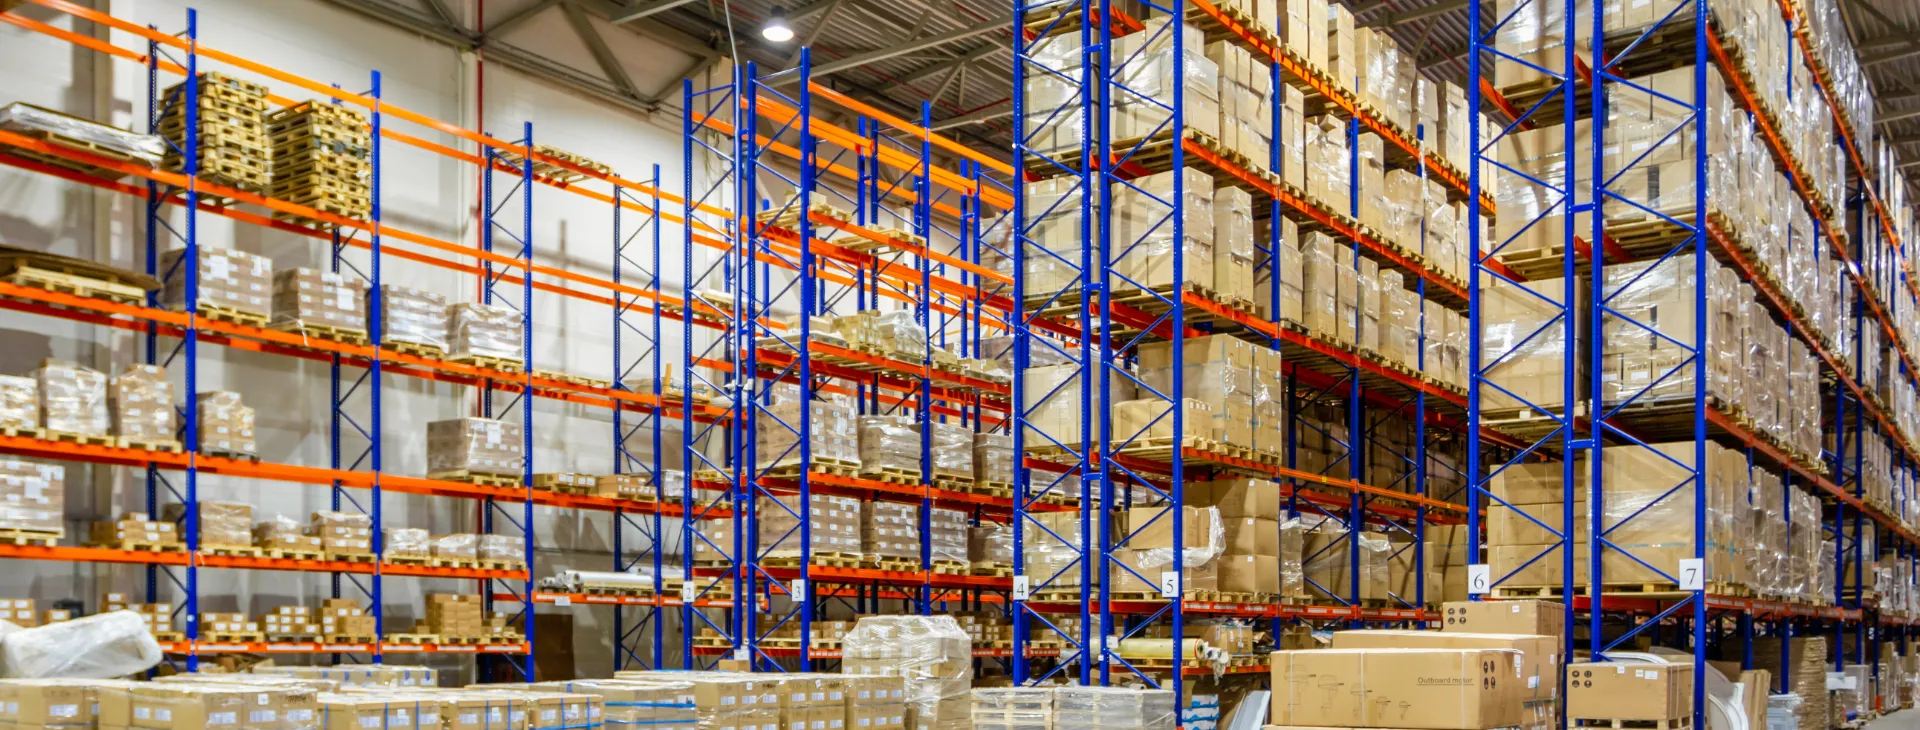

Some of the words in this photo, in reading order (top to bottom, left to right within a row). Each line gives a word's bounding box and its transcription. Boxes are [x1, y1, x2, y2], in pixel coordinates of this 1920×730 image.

[1473, 573, 1484, 590] 6
[1685, 568, 1697, 585] 7
[795, 585, 801, 599] 3
[1016, 582, 1025, 596] 4
[1166, 579, 1174, 594] 5
[1417, 676, 1451, 684] Outboard
